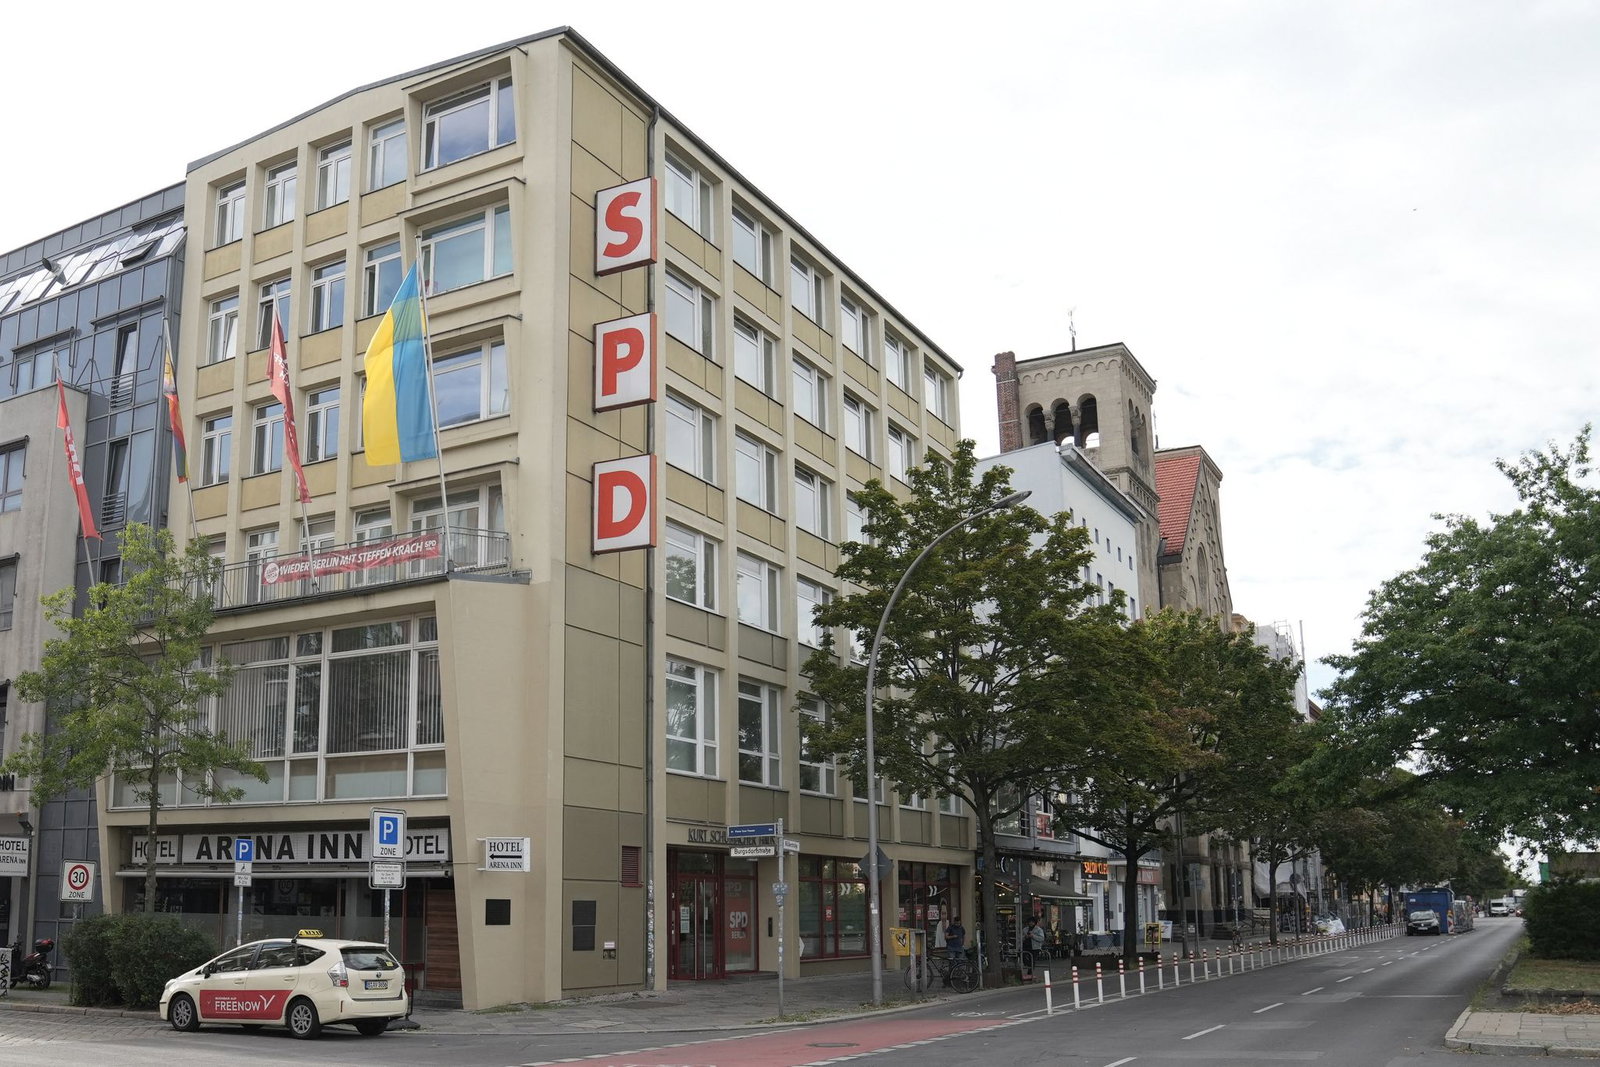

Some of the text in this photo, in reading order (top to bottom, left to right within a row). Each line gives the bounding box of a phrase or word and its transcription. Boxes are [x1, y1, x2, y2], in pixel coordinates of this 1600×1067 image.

[425, 540, 437, 549] SPD
[279, 561, 310, 576] WIEDER
[340, 553, 357, 566] MIT
[358, 549, 391, 563] STEFFEN
[392, 541, 423, 557] KRACH
[688, 828, 707, 843] KURT
[196, 833, 363, 860] ARNA INN
[406, 835, 445, 855] OTEL
[489, 841, 523, 852] HOTEL
[380, 847, 396, 855] ZONE
[0, 855, 18, 864] RENA
[489, 861, 523, 869] ARENA INN
[72, 871, 85, 883] 30
[730, 911, 748, 928] SPD
[215, 1001, 260, 1012] FREENOW
